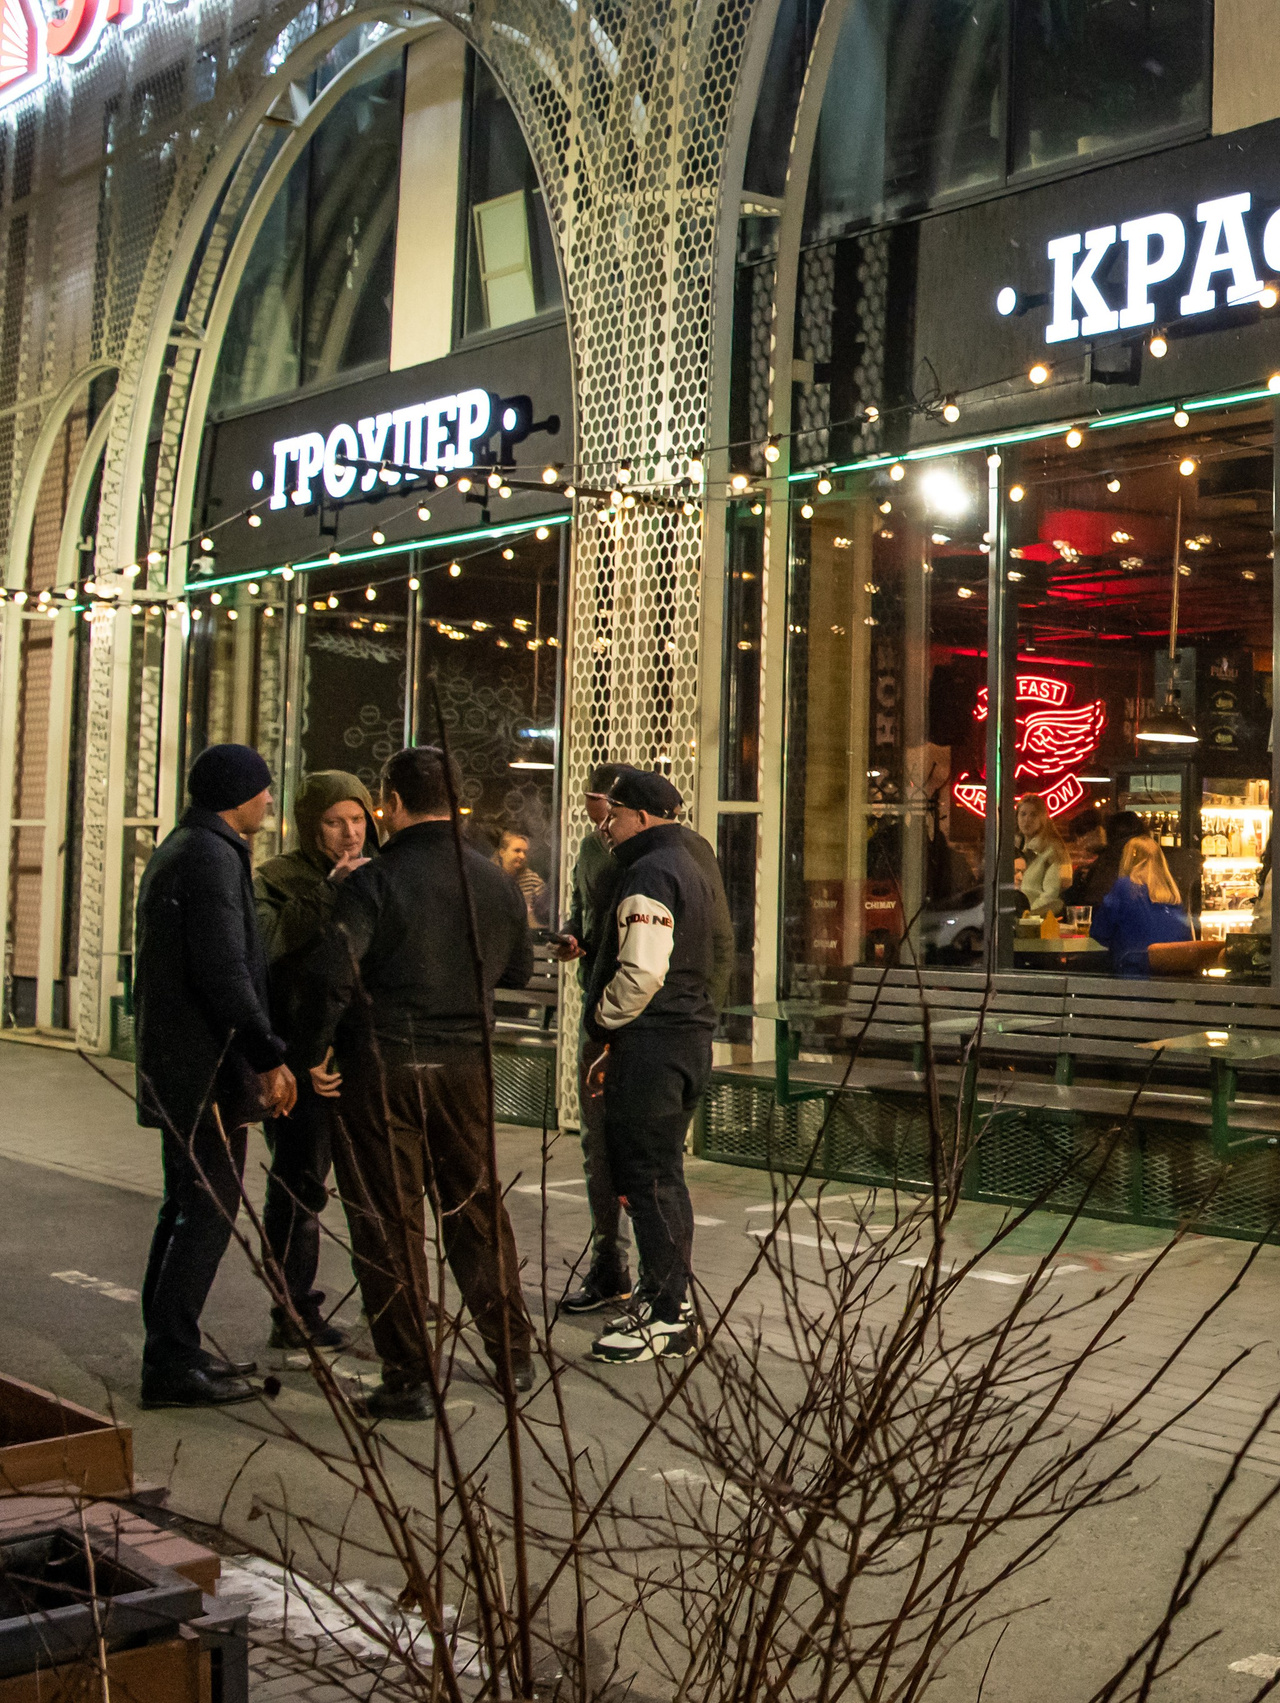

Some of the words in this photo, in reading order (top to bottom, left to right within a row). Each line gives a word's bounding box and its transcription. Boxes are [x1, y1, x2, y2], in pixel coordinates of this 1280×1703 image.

[270, 388, 491, 511] ГРОУЛЕР
[1019, 680, 1061, 700] FAST
[864, 900, 897, 910] CHIMAY
